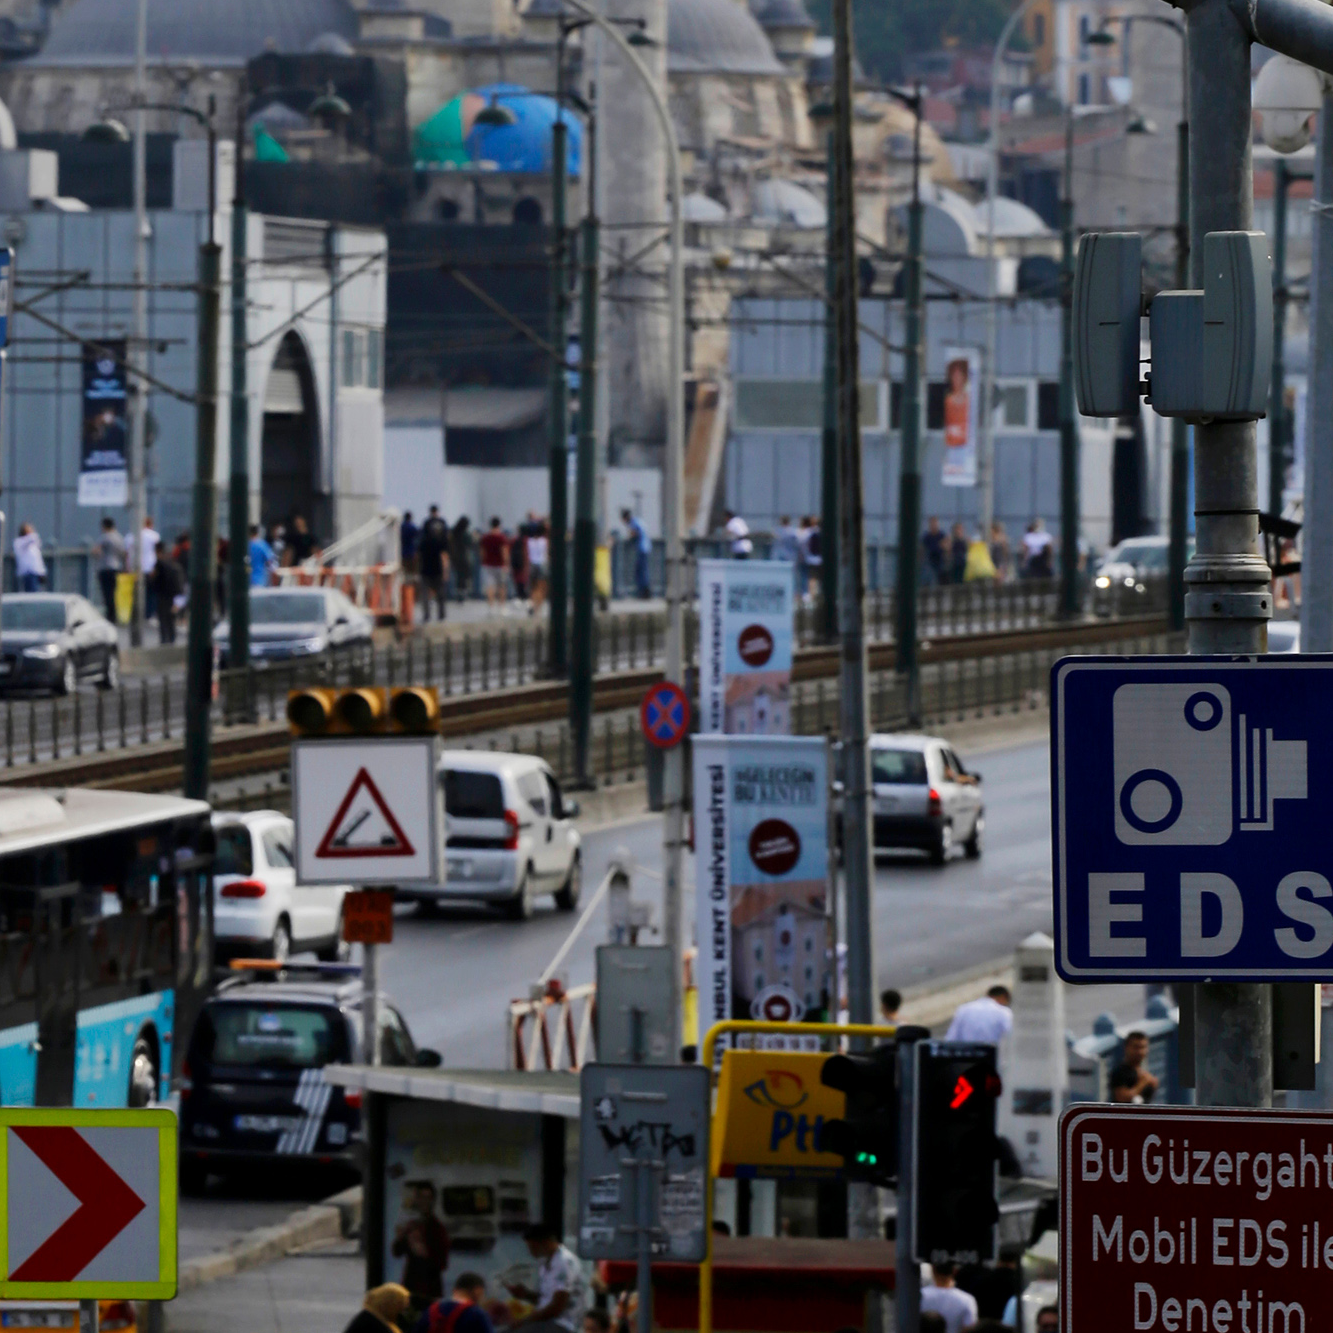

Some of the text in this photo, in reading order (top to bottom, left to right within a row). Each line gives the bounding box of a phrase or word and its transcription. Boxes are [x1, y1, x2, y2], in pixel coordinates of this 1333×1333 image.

[706, 764, 726, 902] ÜNİVERSİTESİ
[711, 908, 726, 960] KENT
[1089, 871, 1333, 958] EDS
[1082, 1133, 1128, 1182] Bu
[1093, 1215, 1196, 1264] Mobil
[1213, 1219, 1289, 1268] EDS
[1134, 1283, 1306, 1333] Denetim
